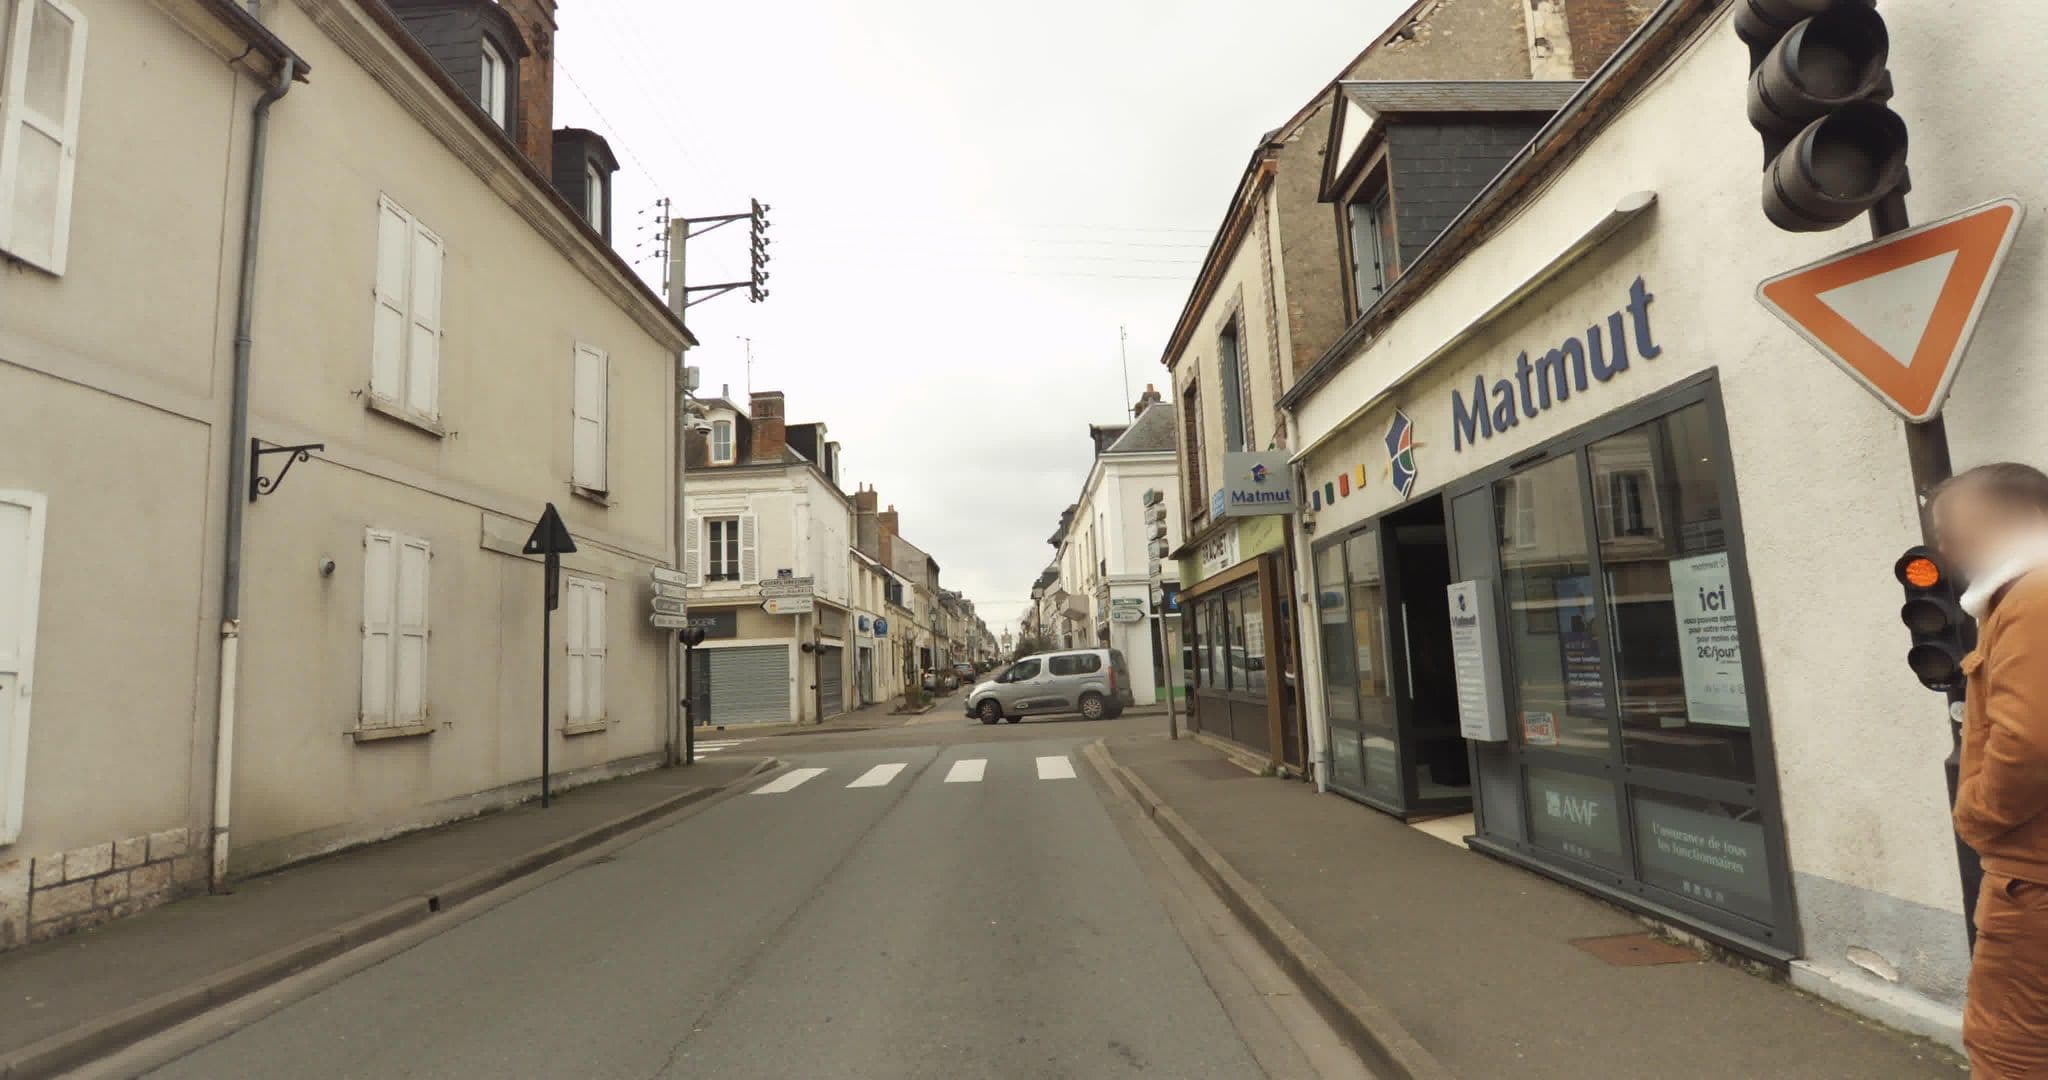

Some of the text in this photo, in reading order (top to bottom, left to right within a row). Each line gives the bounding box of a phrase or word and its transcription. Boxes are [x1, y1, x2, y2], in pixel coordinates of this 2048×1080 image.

[1451, 274, 1662, 453] Matmut
[1231, 489, 1291, 503] Matmut
[1699, 584, 1726, 611] ici
[1563, 795, 1600, 827] AMF
